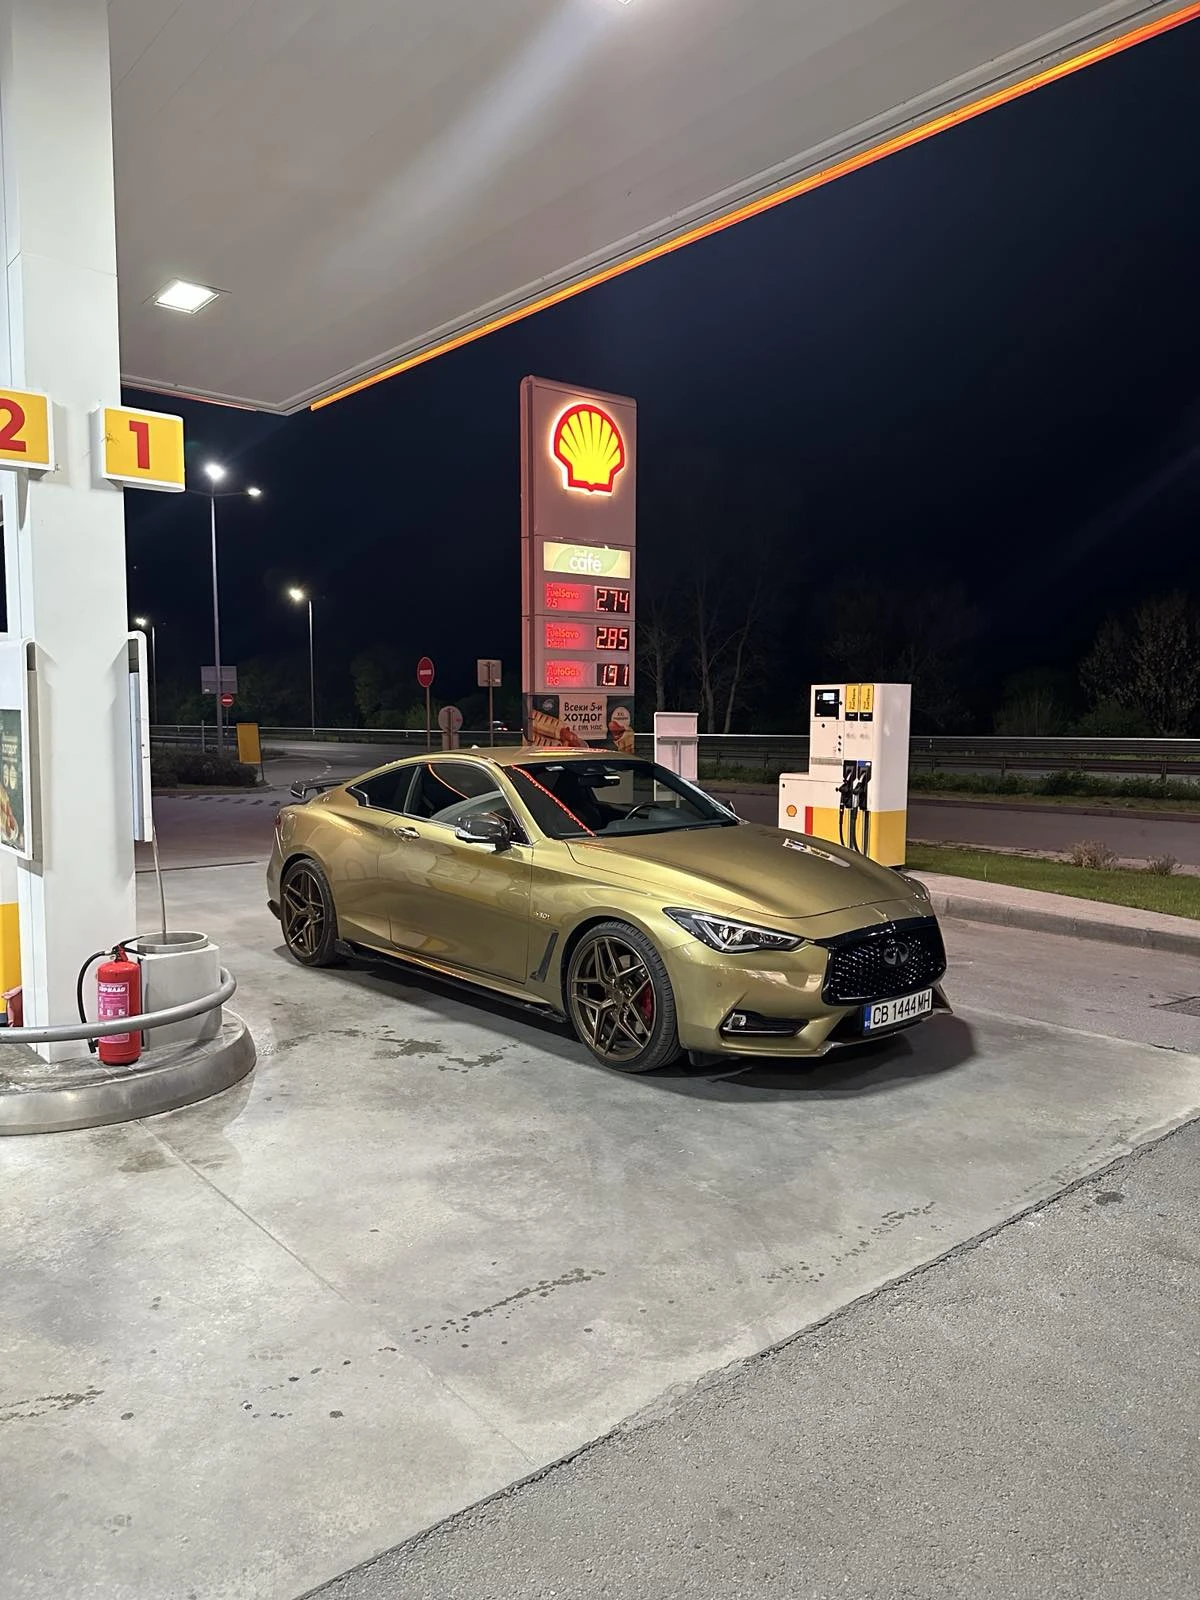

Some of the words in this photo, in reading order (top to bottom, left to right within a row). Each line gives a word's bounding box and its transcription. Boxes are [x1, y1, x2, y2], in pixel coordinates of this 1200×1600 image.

[0, 398, 26, 452] 2
[129, 420, 150, 470] 1
[546, 598, 558, 608] 95
[596, 590, 629, 612] 2.74
[596, 628, 629, 650] 2.85
[564, 702, 588, 711] Всеки
[873, 1005, 888, 1025] CB
[893, 997, 916, 1020] 1444
[918, 991, 930, 1012] MH
